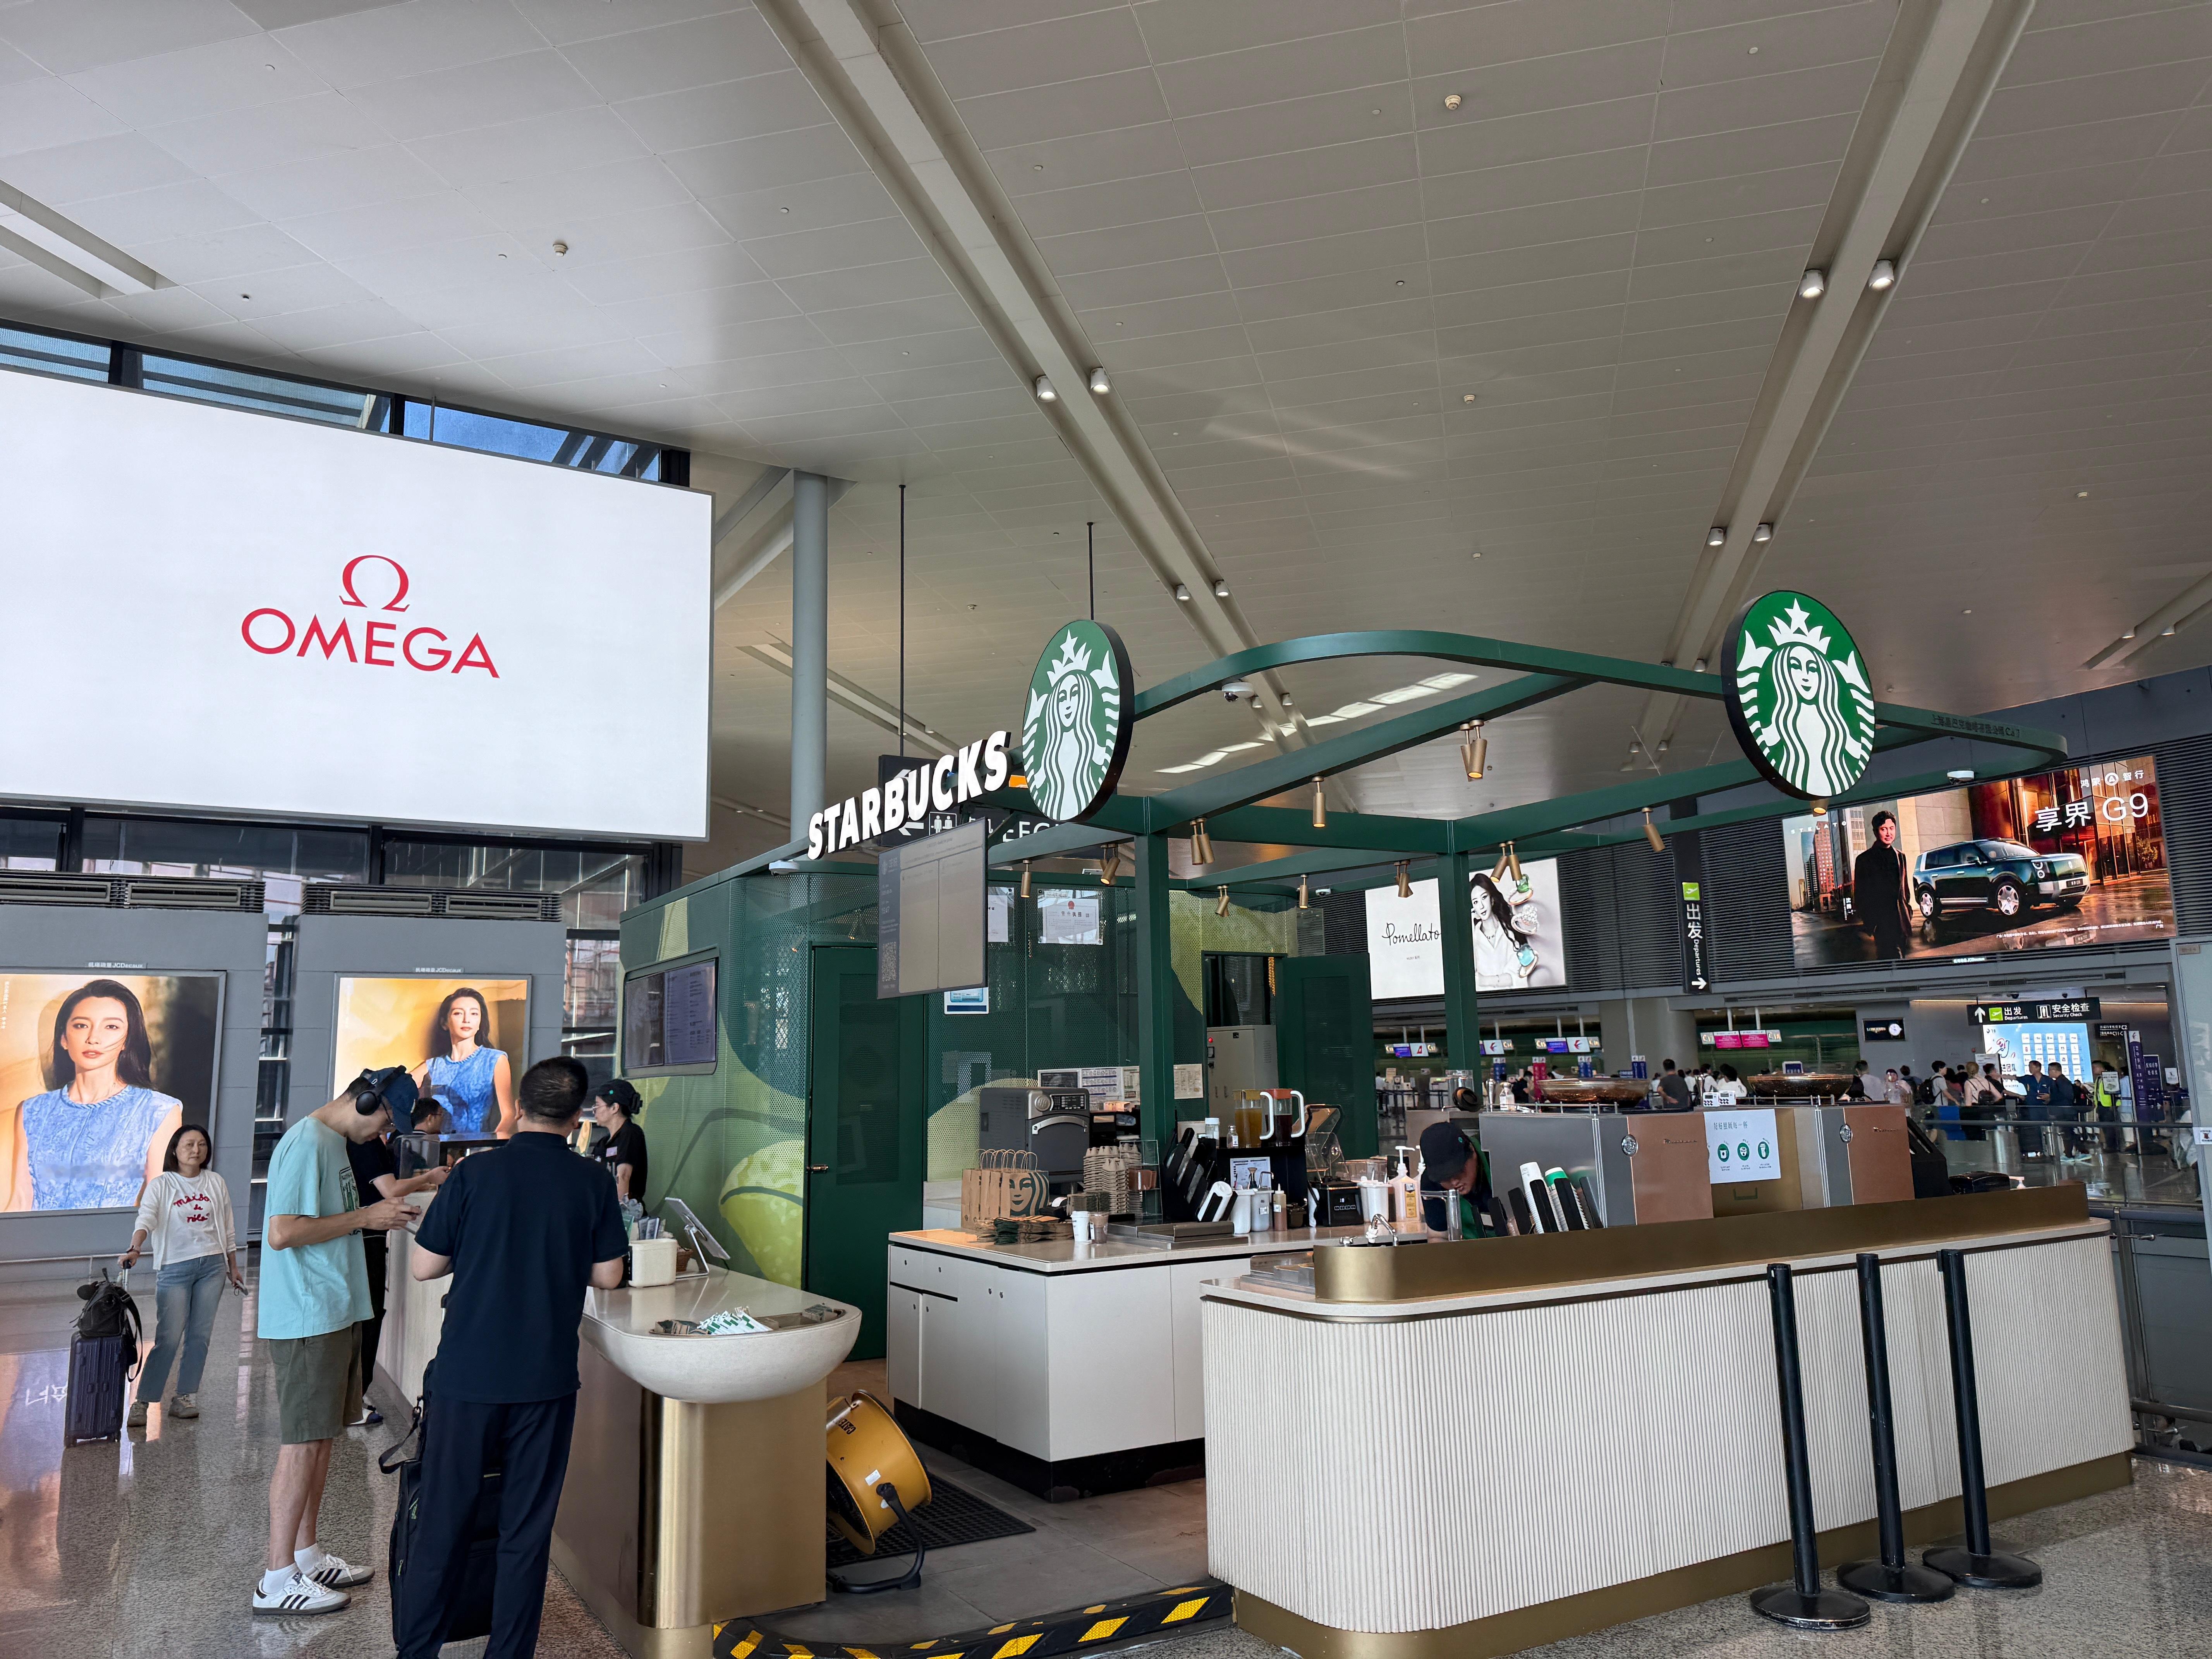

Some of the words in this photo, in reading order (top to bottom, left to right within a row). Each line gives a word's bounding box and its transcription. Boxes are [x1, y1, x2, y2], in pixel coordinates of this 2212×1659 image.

[241, 608, 500, 679] OMEGA
[807, 730, 1008, 860] STARBUCKS
[1791, 821, 1847, 834] STELATO
[2034, 801, 2091, 832] 享界
[2102, 793, 2148, 821] G9
[1381, 922, 1441, 946] Pomellato
[1687, 903, 1702, 939] 出发
[2004, 1006, 2022, 1015] 出发
[2052, 1003, 2090, 1013] 安全检查
[173, 1192, 211, 1207] maiso
